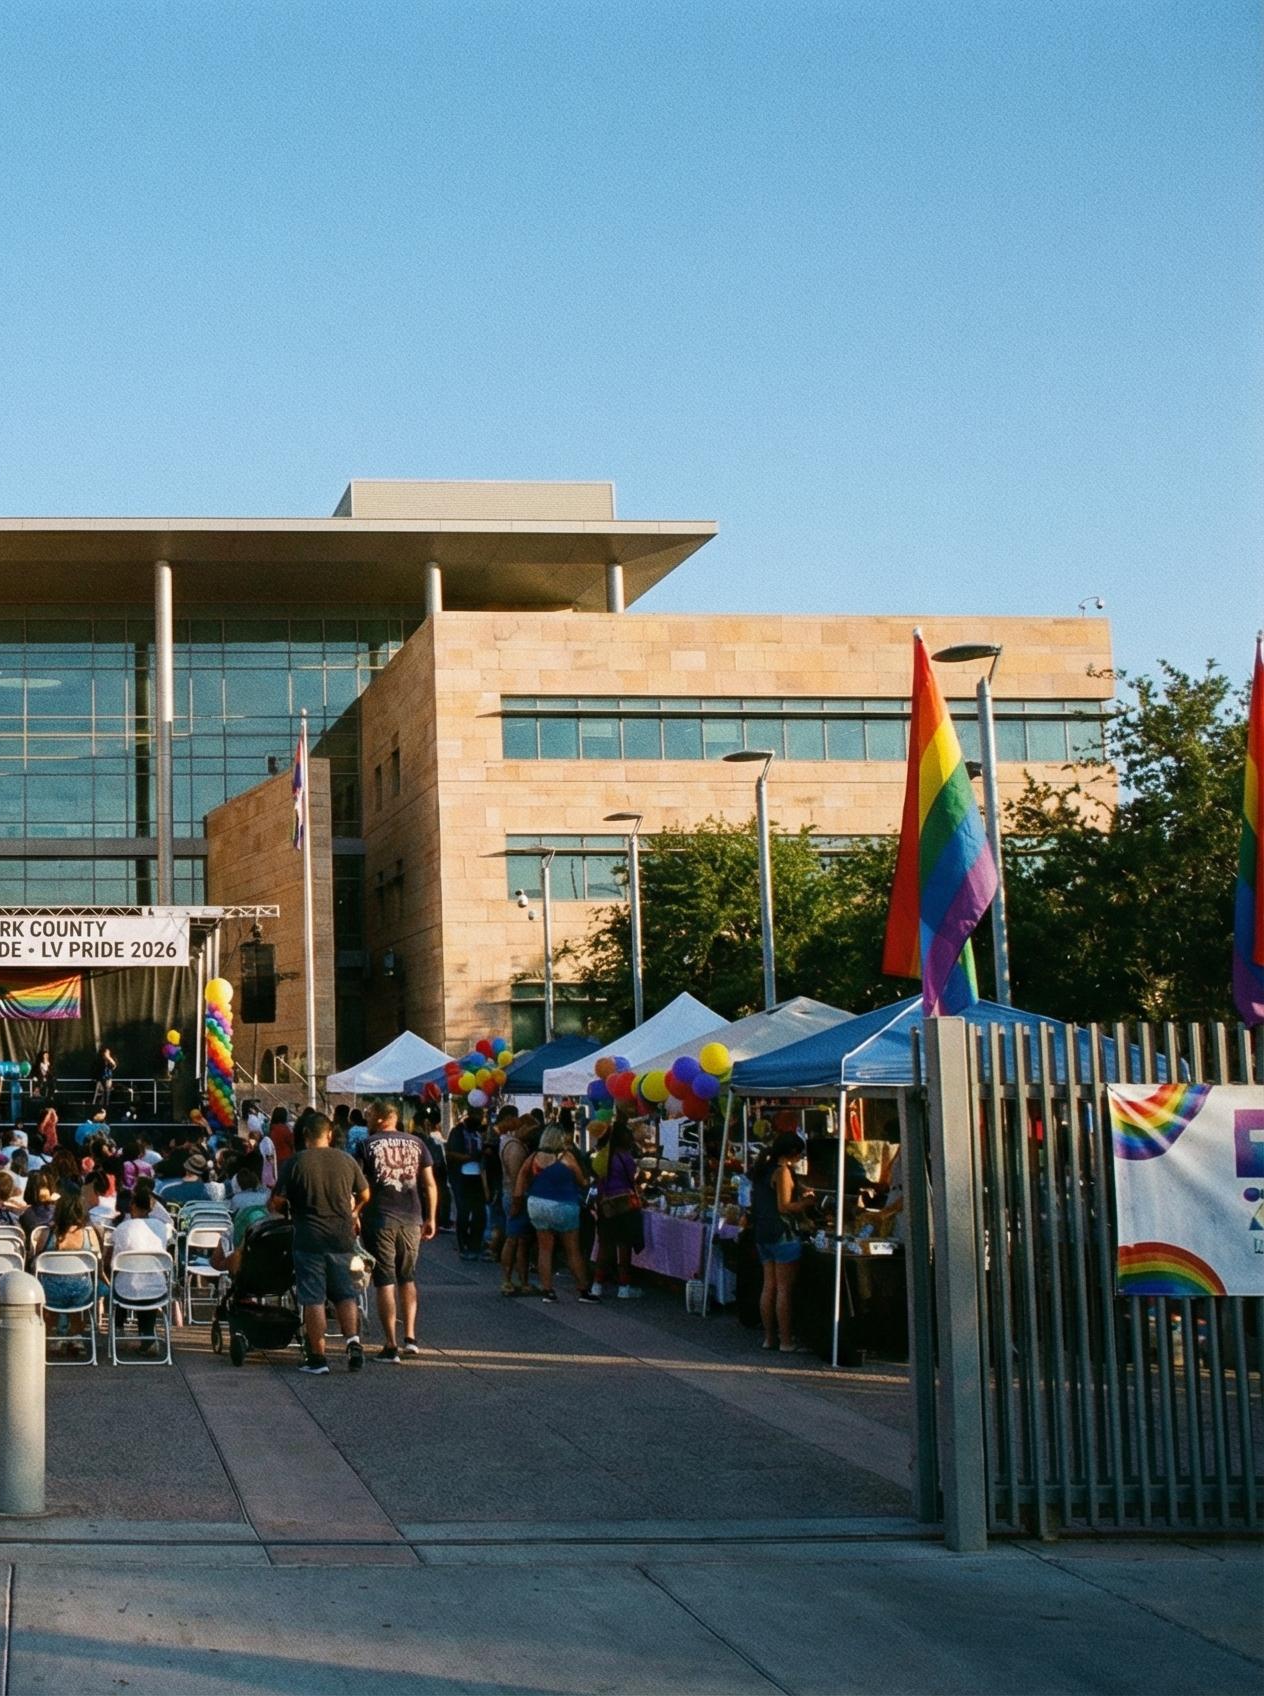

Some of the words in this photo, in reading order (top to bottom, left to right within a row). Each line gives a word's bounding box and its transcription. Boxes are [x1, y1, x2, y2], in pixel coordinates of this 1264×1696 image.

[29, 920, 107, 938] COUNTY
[41, 941, 64, 958] LV
[69, 941, 125, 958] PRIDE
[130, 941, 177, 958] 2026
